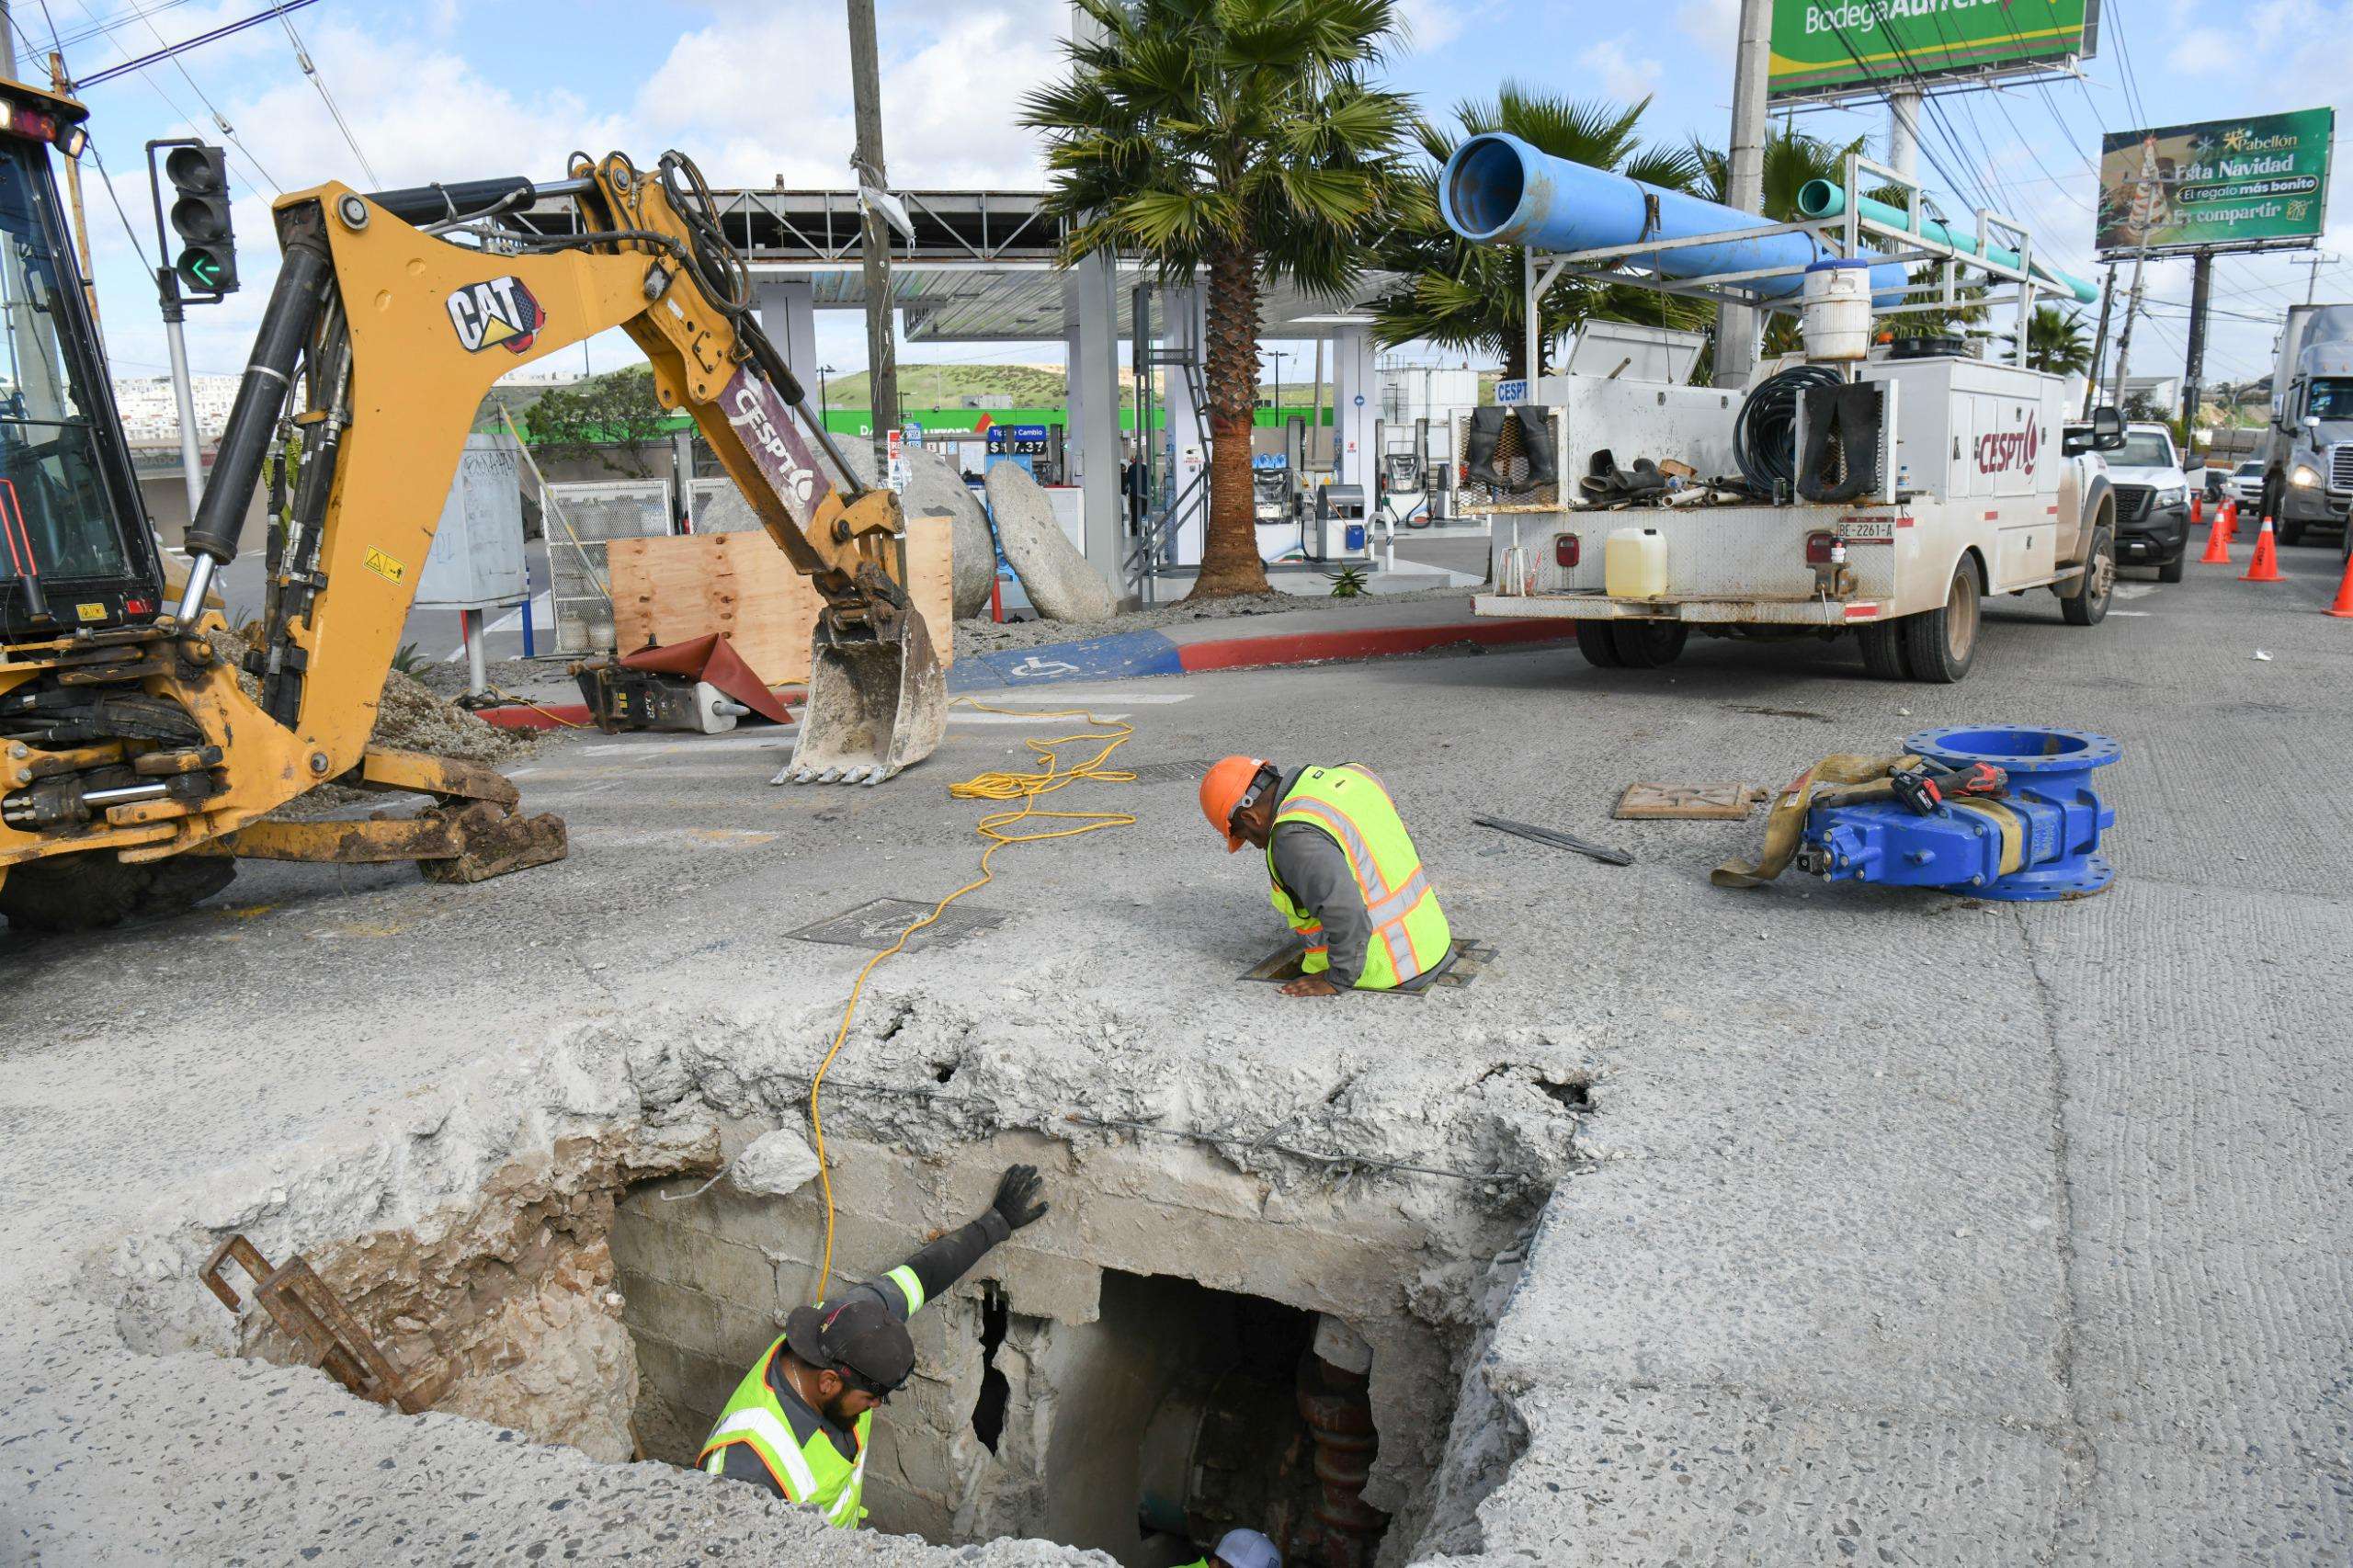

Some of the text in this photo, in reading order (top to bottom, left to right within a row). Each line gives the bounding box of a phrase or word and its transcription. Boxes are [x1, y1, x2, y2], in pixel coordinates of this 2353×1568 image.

[1805, 1, 1889, 34] Bodega
[2237, 135, 2297, 151] Pabellón
[2219, 154, 2294, 177] Navidad
[2184, 177, 2316, 200] El regalo más bonito
[2197, 202, 2281, 225] compartir
[447, 276, 525, 350] CAT
[1497, 381, 1529, 402] CESPT
[1017, 428, 1043, 437] Cambio
[1839, 523, 1893, 538] BE-2261-A
